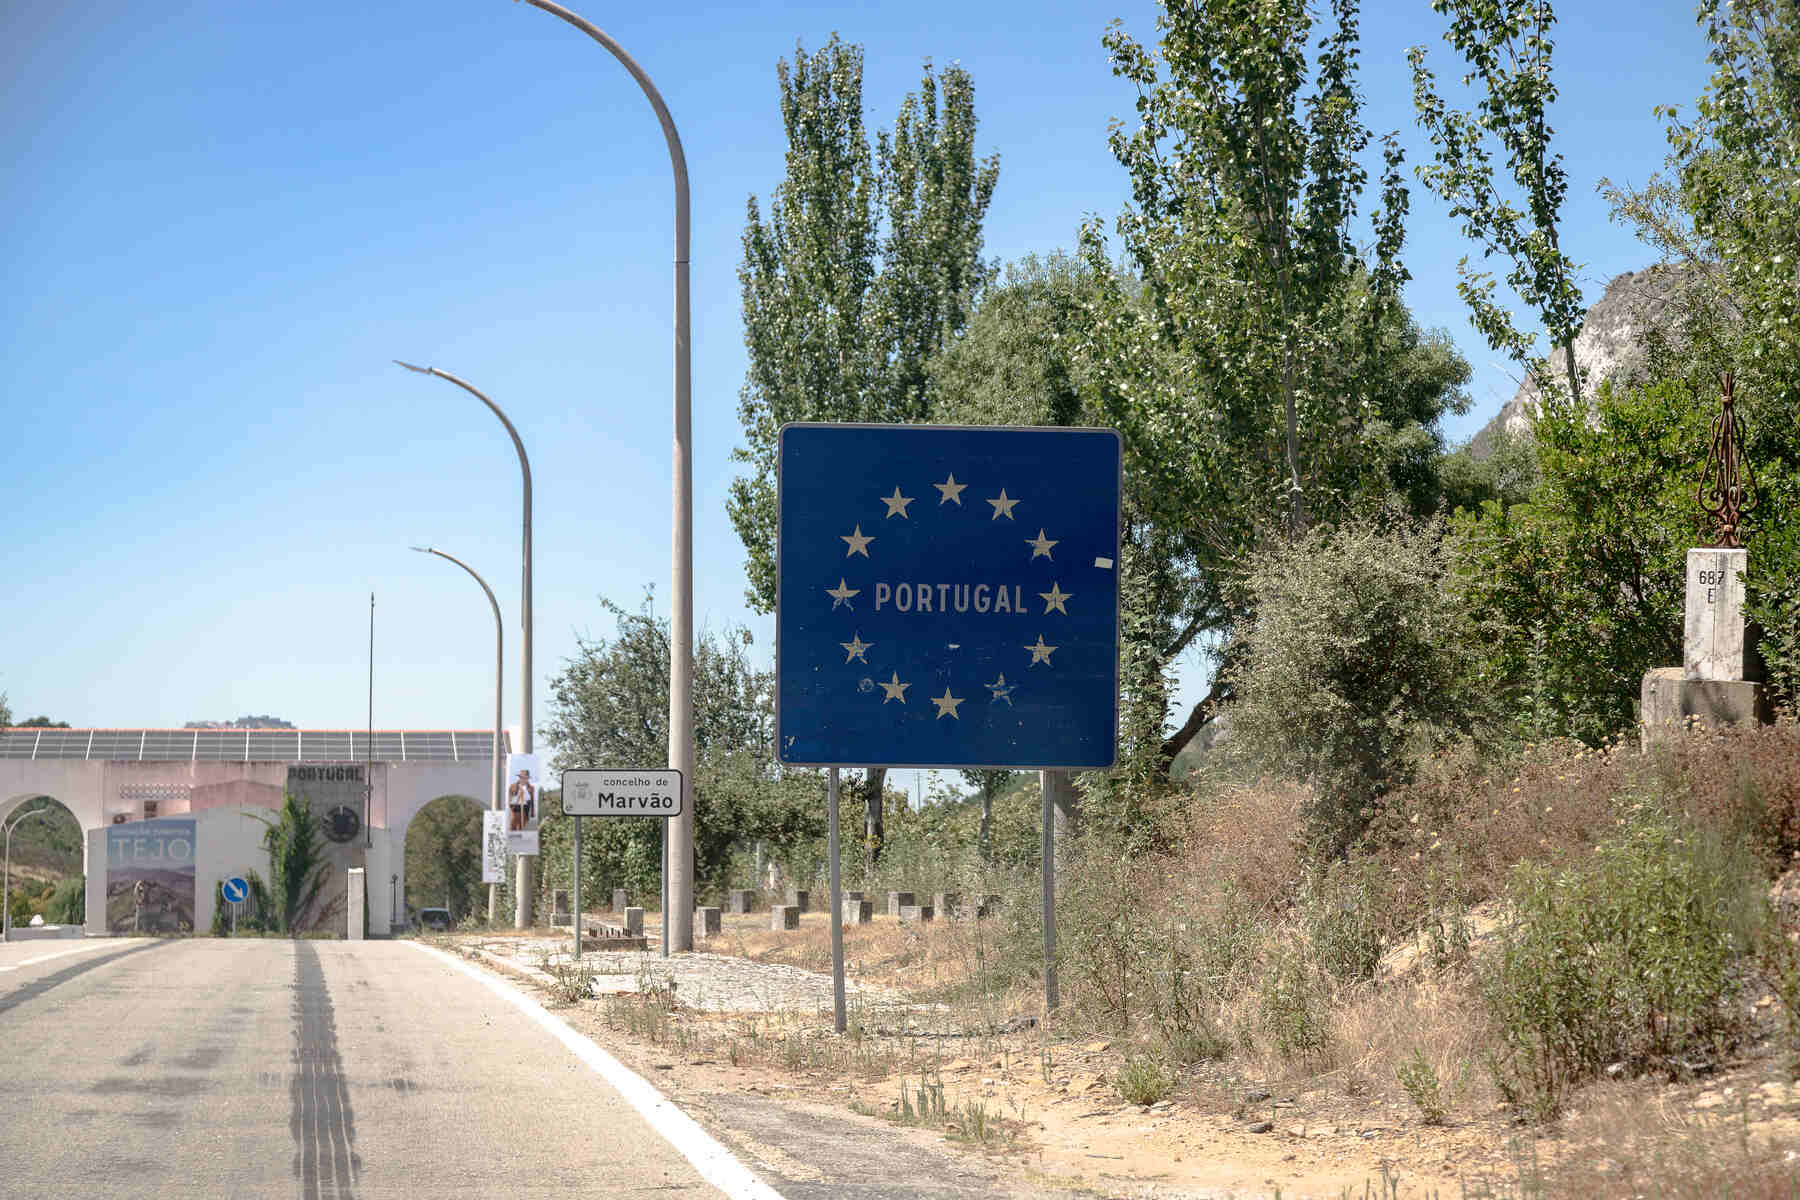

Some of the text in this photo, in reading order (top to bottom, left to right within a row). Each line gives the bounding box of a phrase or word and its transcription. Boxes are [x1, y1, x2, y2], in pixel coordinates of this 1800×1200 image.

[1699, 570, 1725, 585] 687
[875, 583, 1028, 614] PORTUGAL
[288, 766, 364, 782] PORTUGAL
[603, 777, 669, 787] concelho de
[598, 791, 673, 809] Marvão
[113, 838, 191, 862] TEJO
